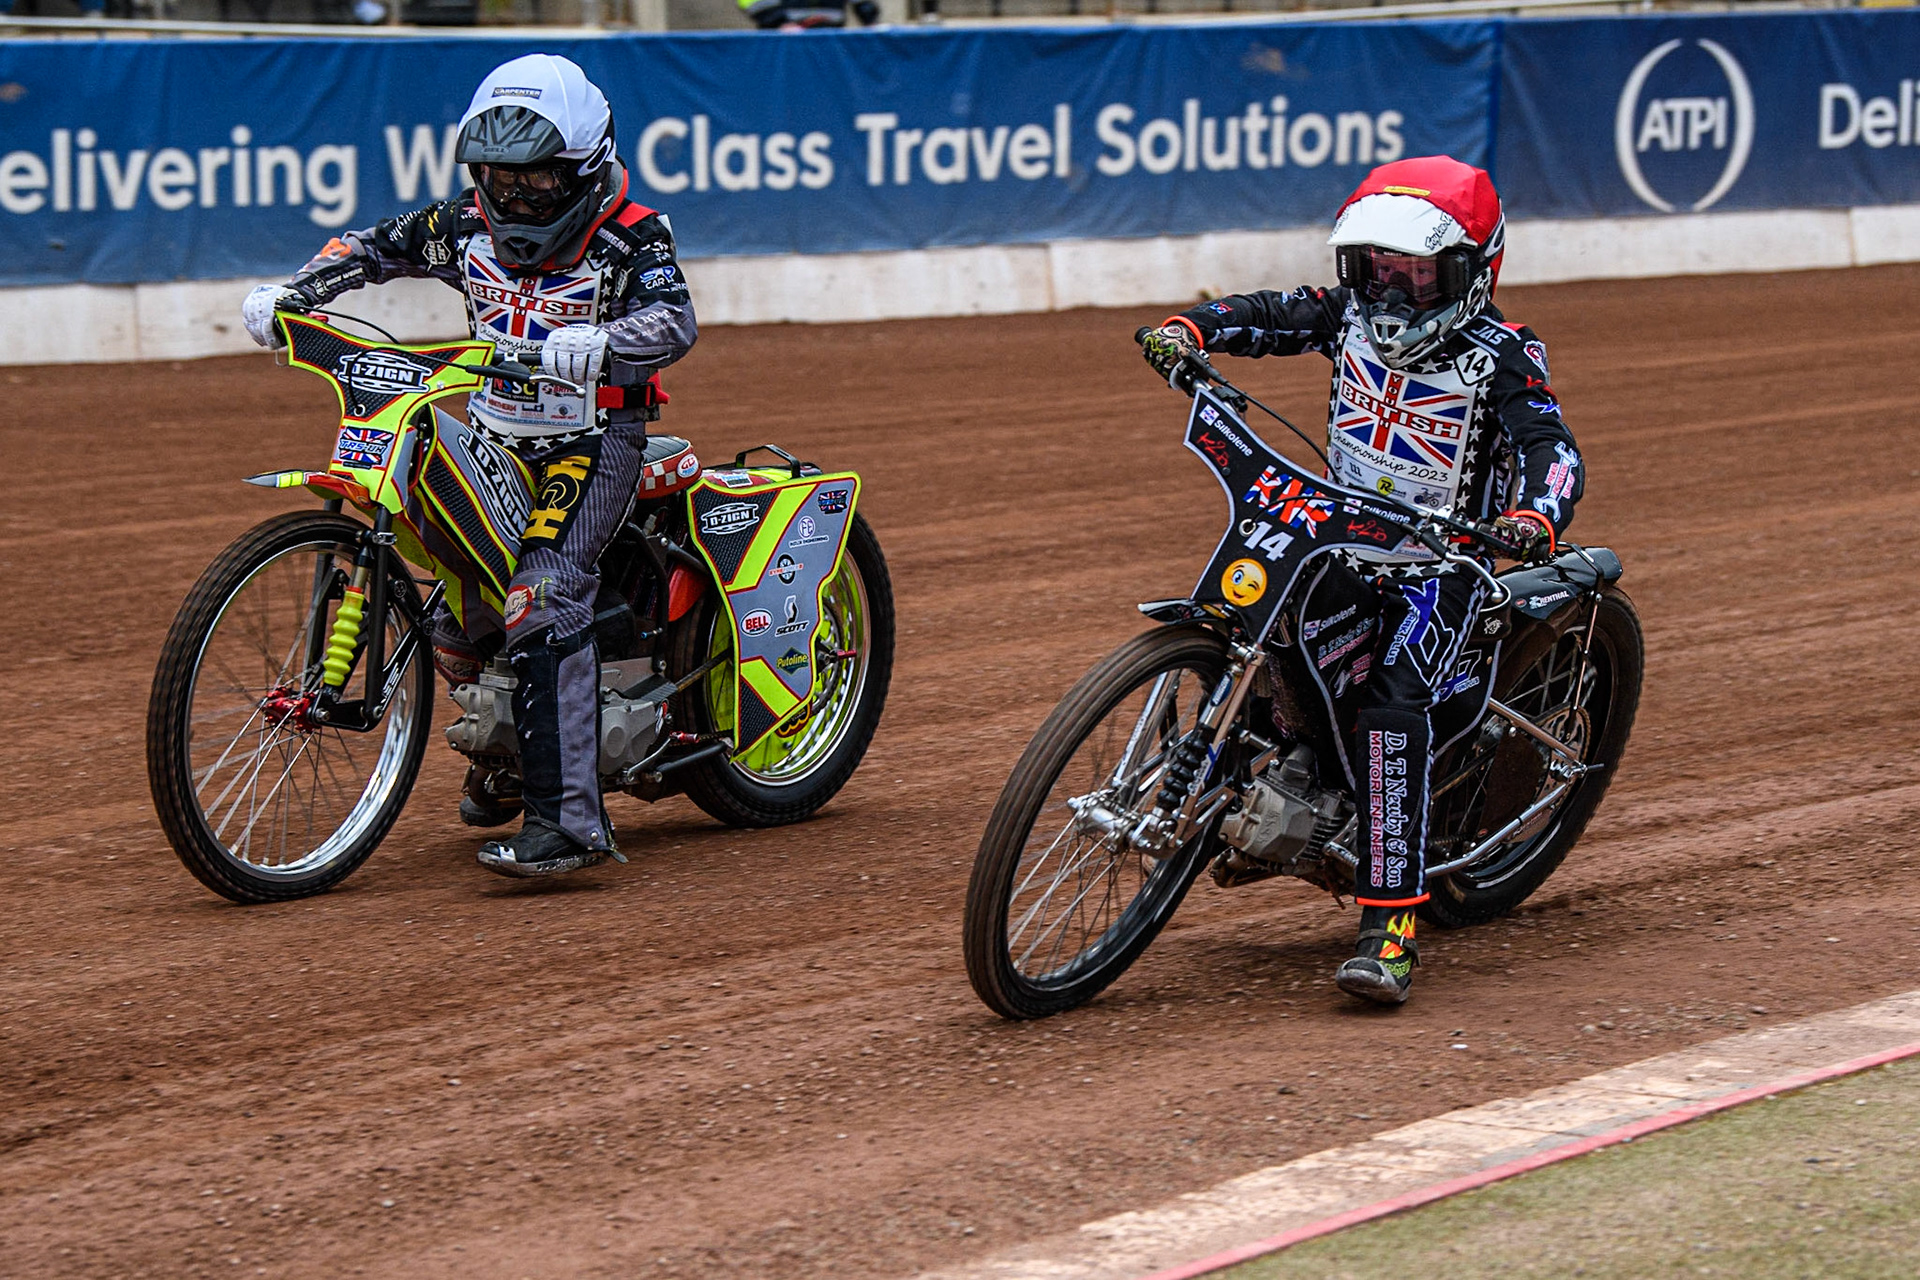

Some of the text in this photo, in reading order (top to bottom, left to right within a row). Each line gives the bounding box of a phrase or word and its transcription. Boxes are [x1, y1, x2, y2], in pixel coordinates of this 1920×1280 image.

[494, 88, 541, 98] CARPENTER
[1637, 98, 1728, 152] ATPI
[637, 115, 833, 193] Class
[855, 103, 1071, 186] Travel
[1096, 96, 1404, 176] Solutions
[471, 283, 589, 315] BRITISH
[645, 277, 665, 289] CAR
[1471, 326, 1509, 345] JAS
[1463, 351, 1490, 377] 14
[1341, 384, 1460, 438] BRITISH
[1214, 418, 1253, 457] Silkolene
[1332, 429, 1406, 474] Championship
[1409, 465, 1449, 482] 2023
[474, 448, 528, 533] D-ZIGN
[709, 508, 750, 527] D-ZIGN
[1243, 519, 1295, 562] 14
[745, 615, 769, 631] BELL
[775, 621, 809, 636] SCOTT
[777, 653, 808, 669] Putoline
[1384, 634, 1406, 666] PLUS
[1369, 731, 1384, 888] MOTOR ENGINEERS
[1384, 779, 1409, 840] Newby
[1387, 856, 1408, 888] Son
